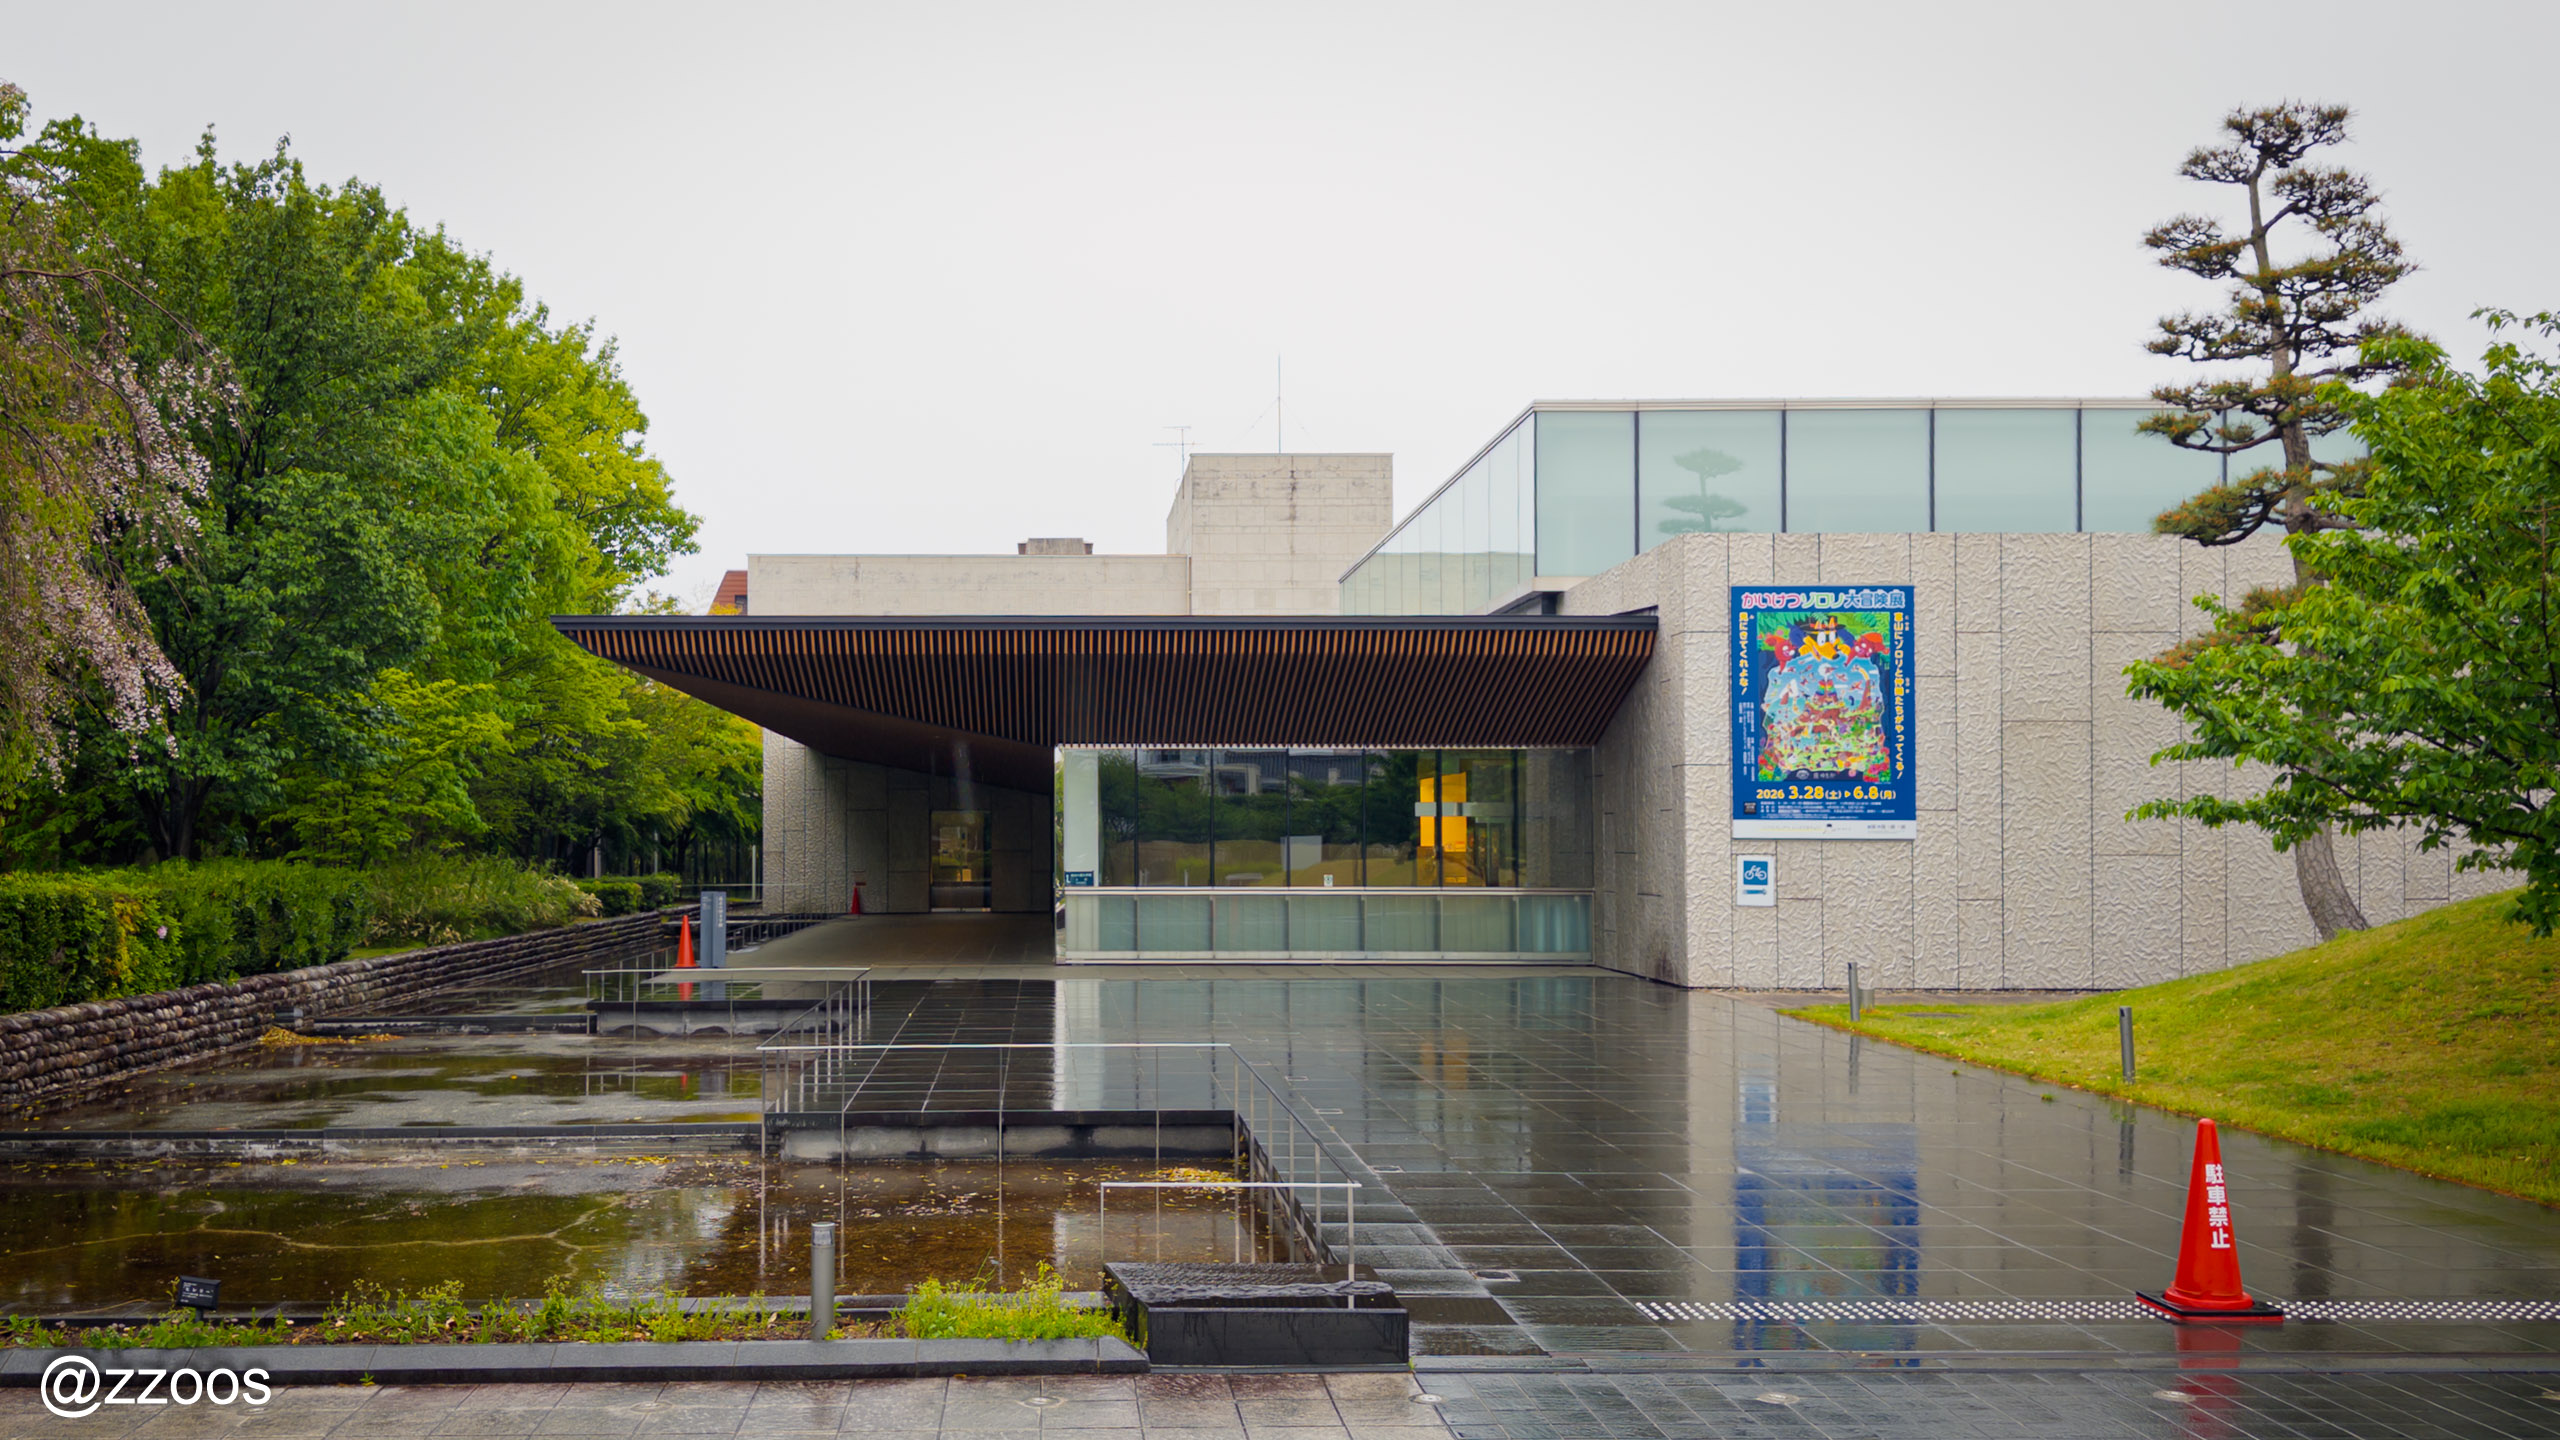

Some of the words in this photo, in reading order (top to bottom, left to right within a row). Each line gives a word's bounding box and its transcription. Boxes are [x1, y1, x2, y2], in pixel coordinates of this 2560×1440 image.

[1756, 789, 1785, 799] 2026
[2205, 1163, 2231, 1249] 駐車禁止
